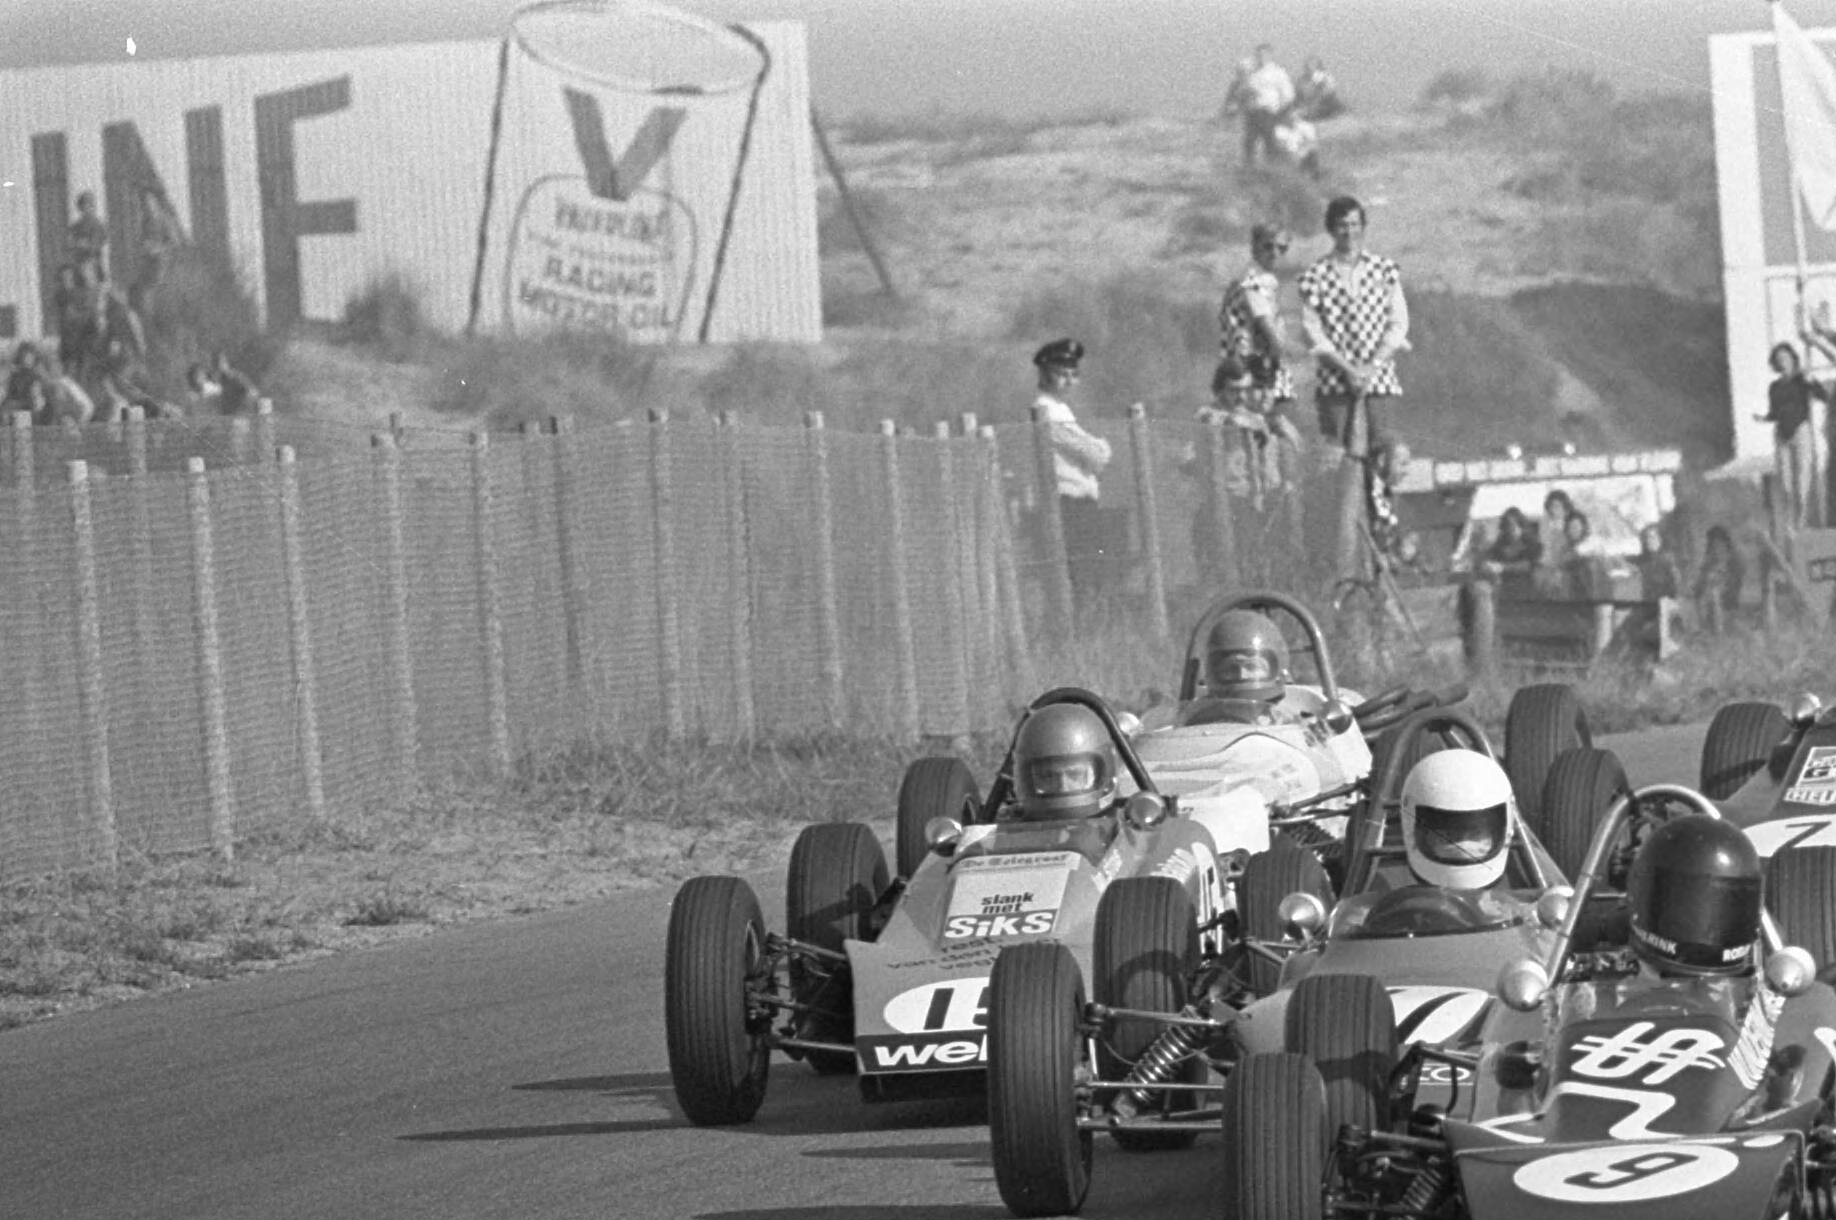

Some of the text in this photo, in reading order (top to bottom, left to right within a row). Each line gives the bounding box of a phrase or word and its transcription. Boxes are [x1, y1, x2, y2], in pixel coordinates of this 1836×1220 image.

[0, 74, 358, 345] INE
[544, 256, 656, 297] RACING
[630, 303, 675, 330] OIL
[1776, 821, 1833, 852] 7
[980, 892, 1035, 907] slank
[982, 902, 1024, 914] met
[1563, 1152, 1700, 1190] 9
